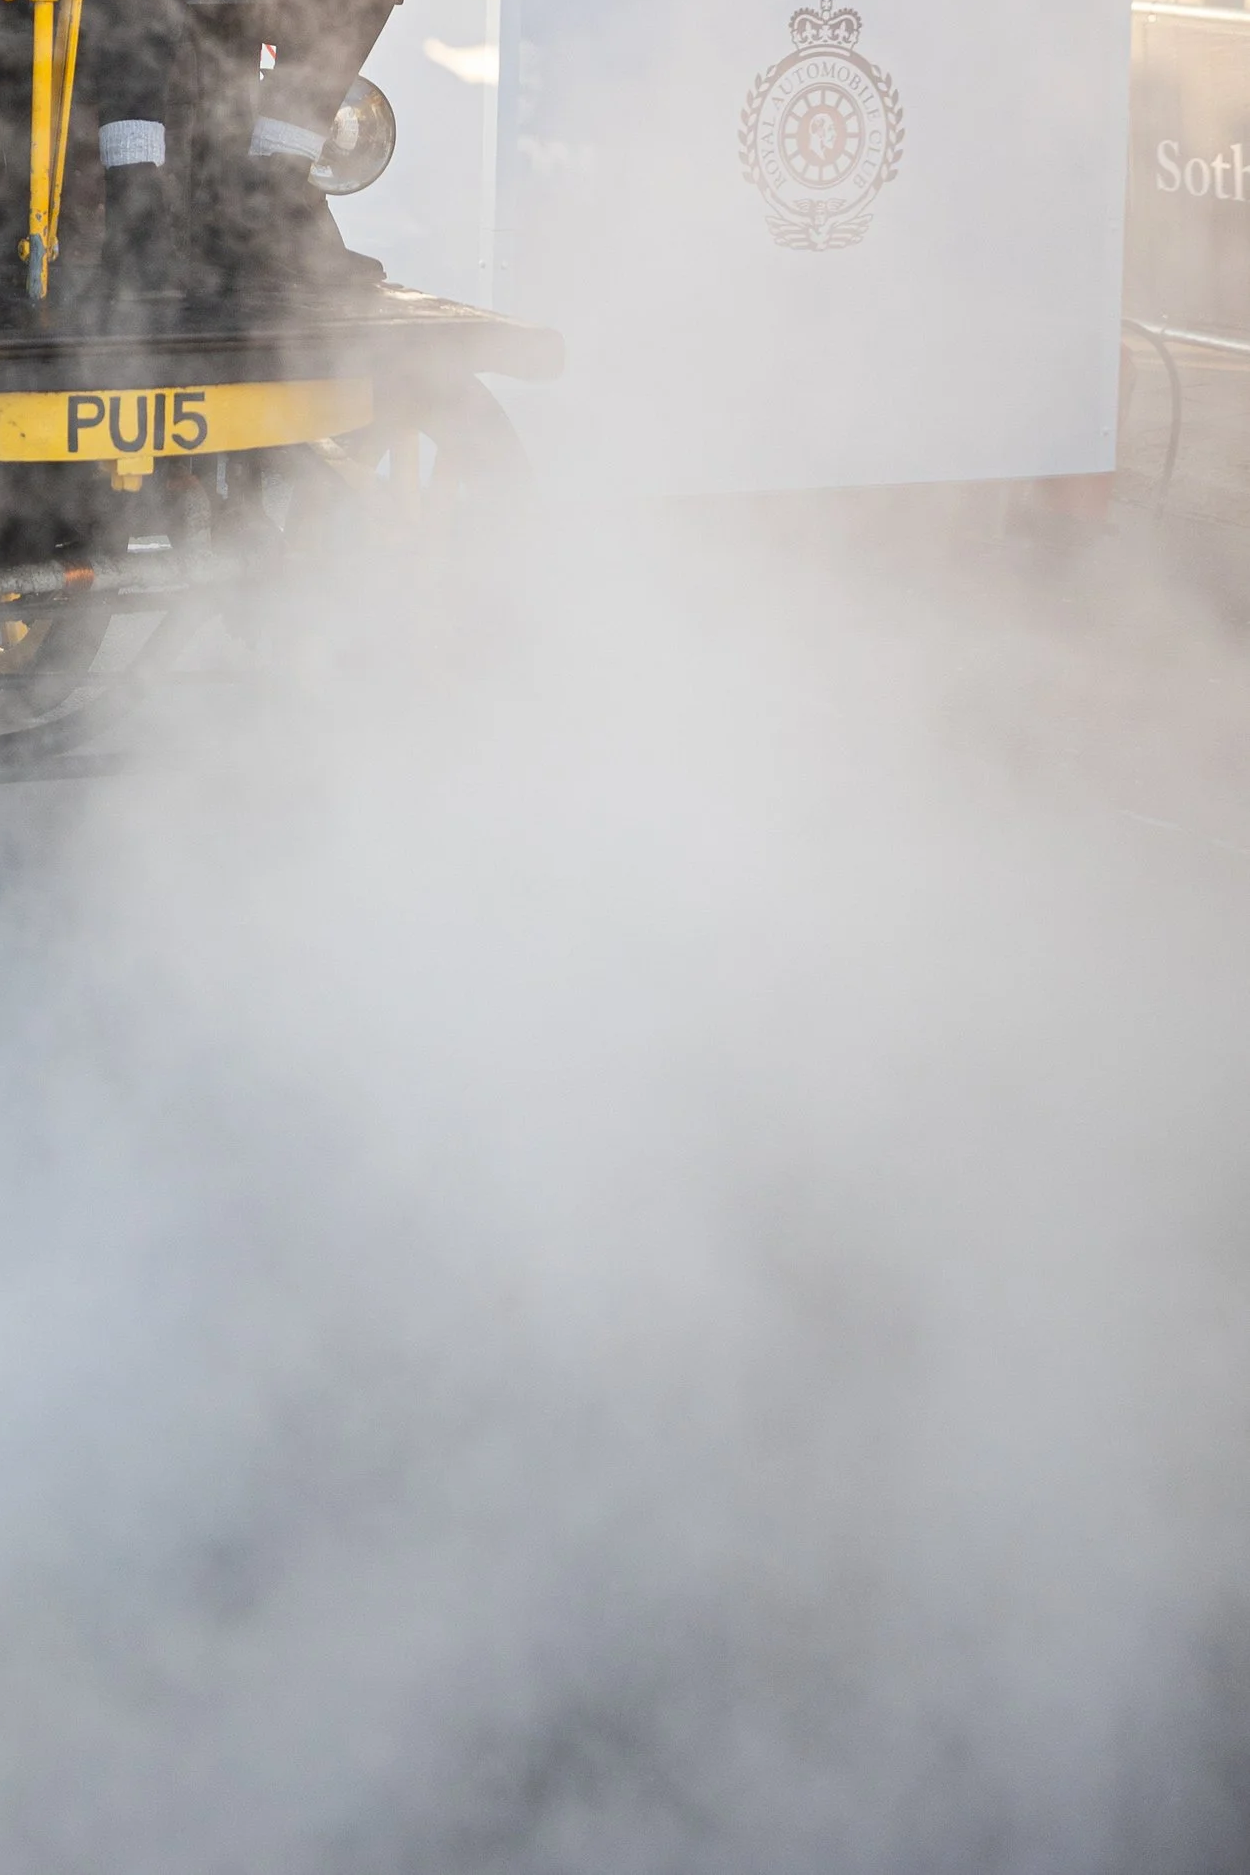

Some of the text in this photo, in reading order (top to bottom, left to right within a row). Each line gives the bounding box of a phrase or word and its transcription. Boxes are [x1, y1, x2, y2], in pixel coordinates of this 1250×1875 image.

[760, 61, 883, 190] ROYAL AUTOMOBILE CLUB
